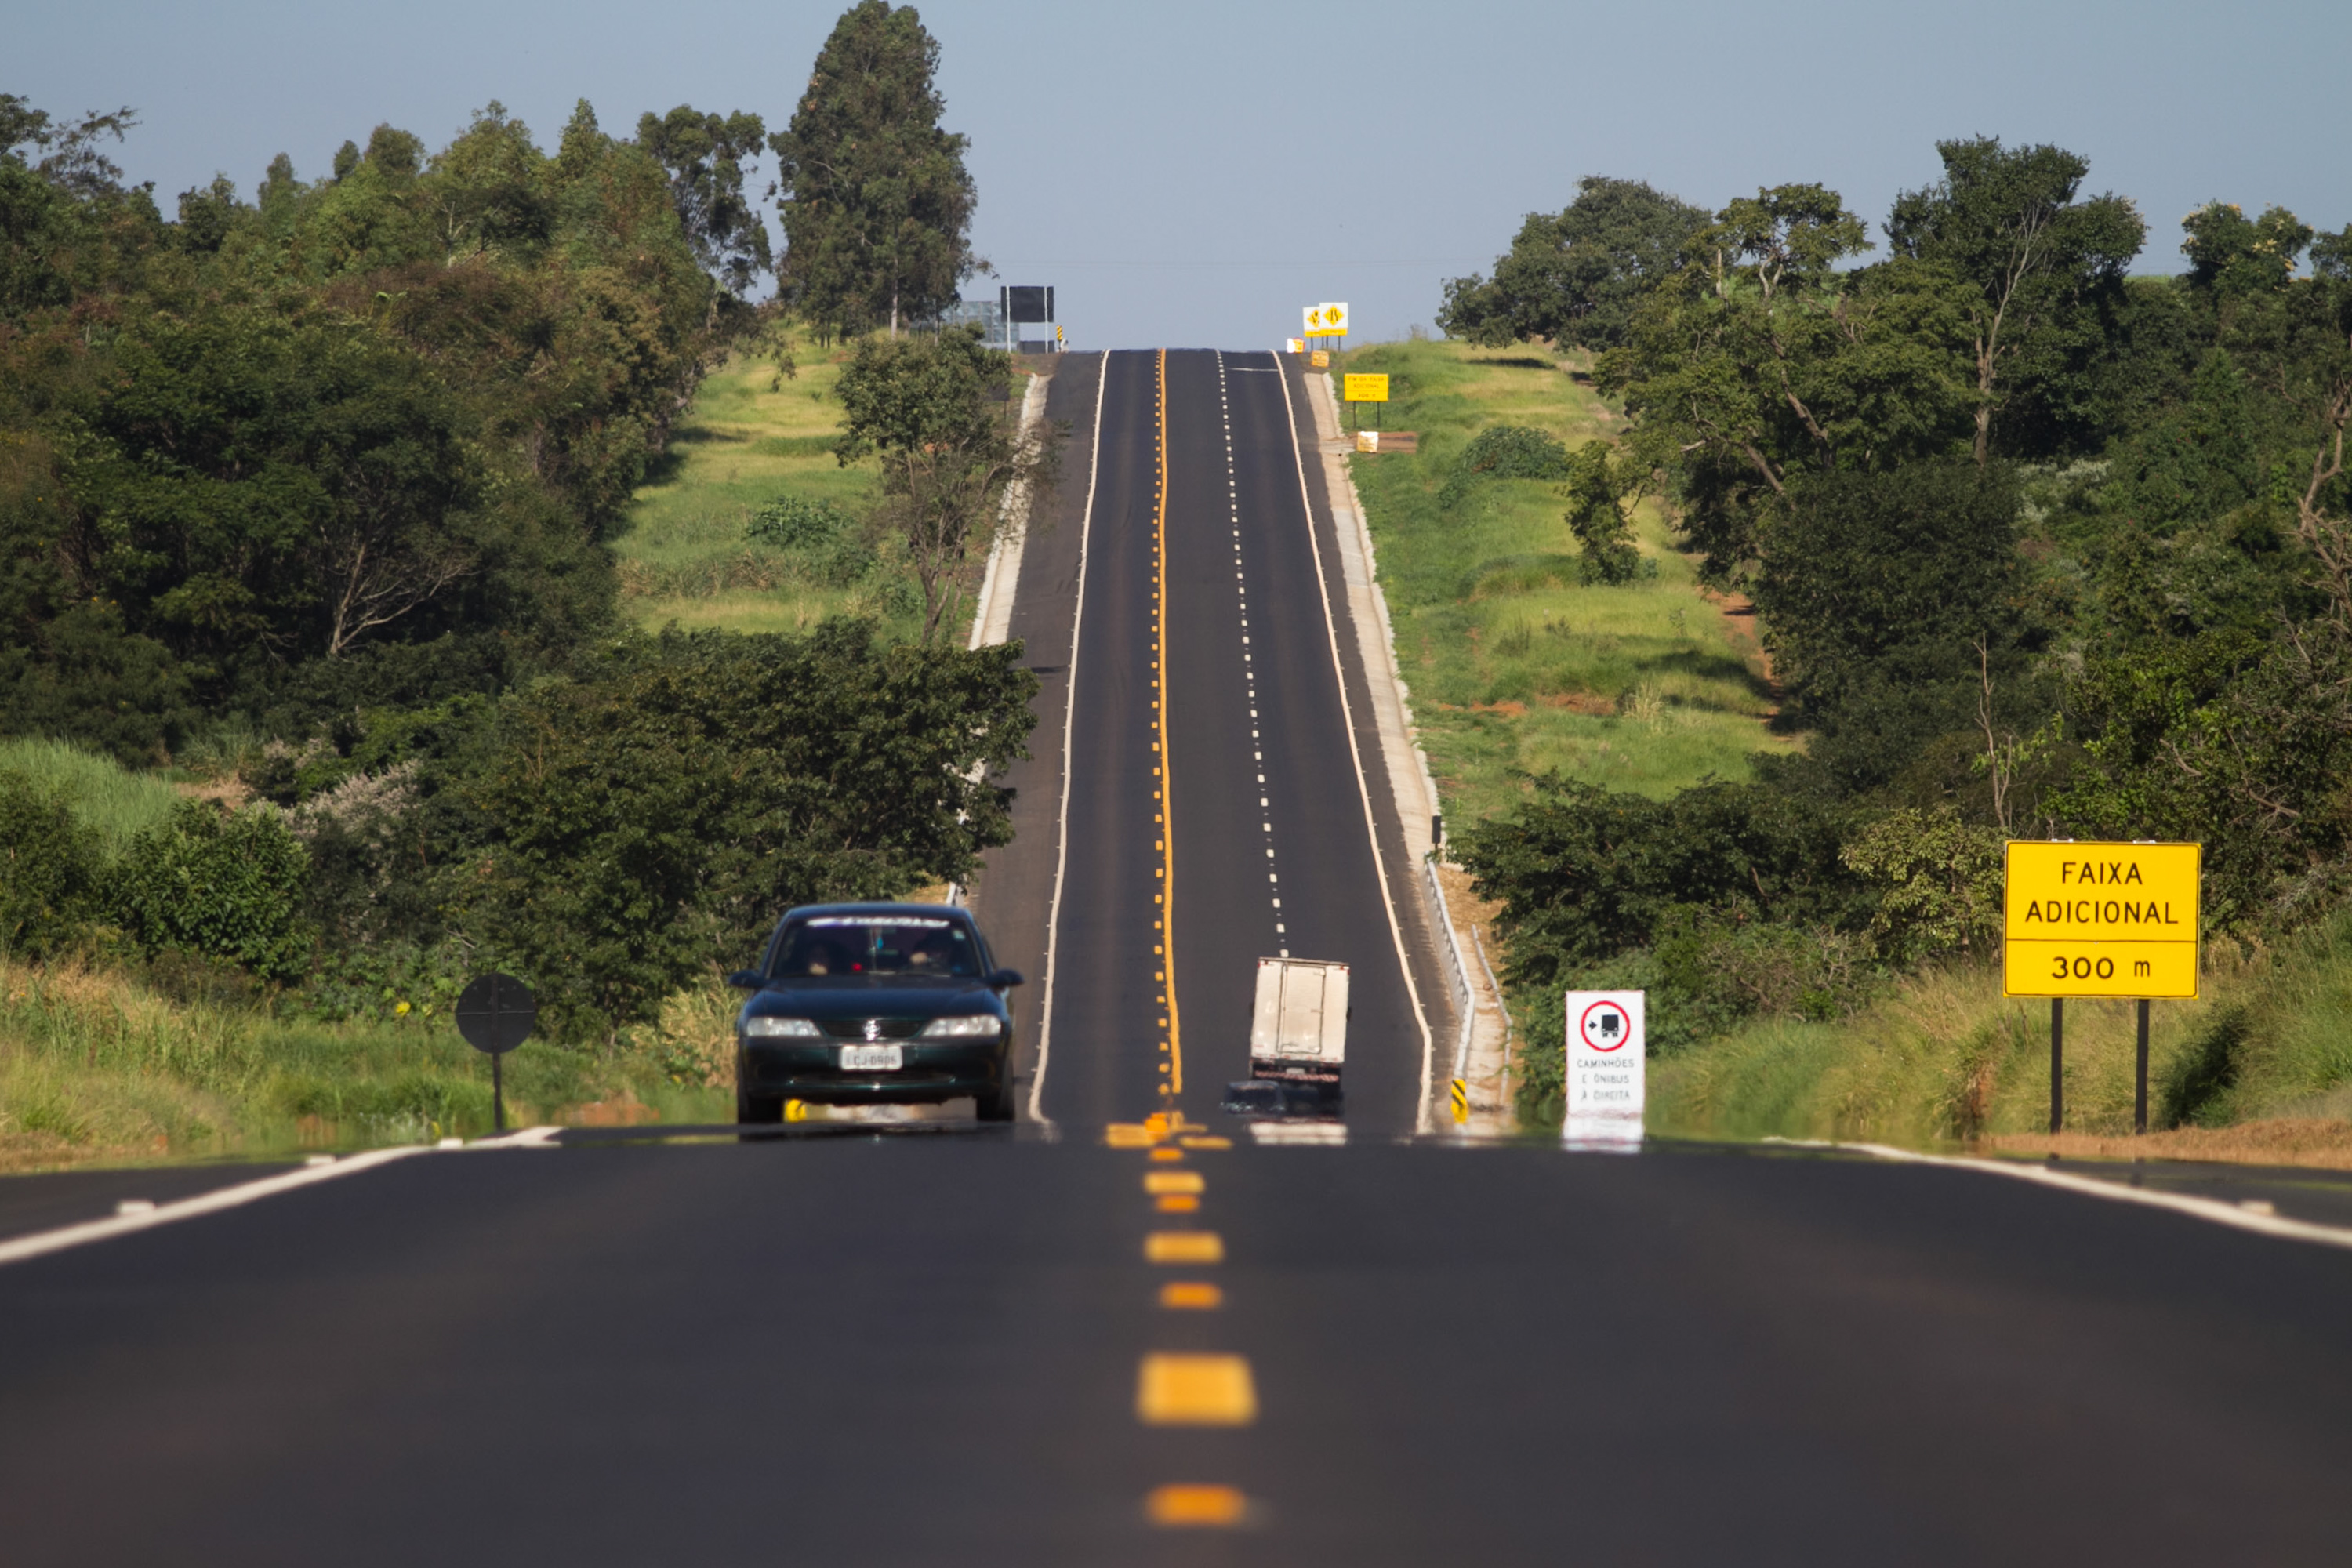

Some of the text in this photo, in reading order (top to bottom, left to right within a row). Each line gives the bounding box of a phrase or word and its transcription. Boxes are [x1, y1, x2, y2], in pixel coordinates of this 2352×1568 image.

[2061, 862, 2143, 885] FAIXA
[2024, 900, 2179, 924] ADICIONAL
[2051, 956, 2151, 980] 300 m
[1577, 1056, 1635, 1069] CAMINHÕES
[1581, 1072, 1630, 1084] E ÔNIBUS
[1593, 1089, 1632, 1102] DIREITA
